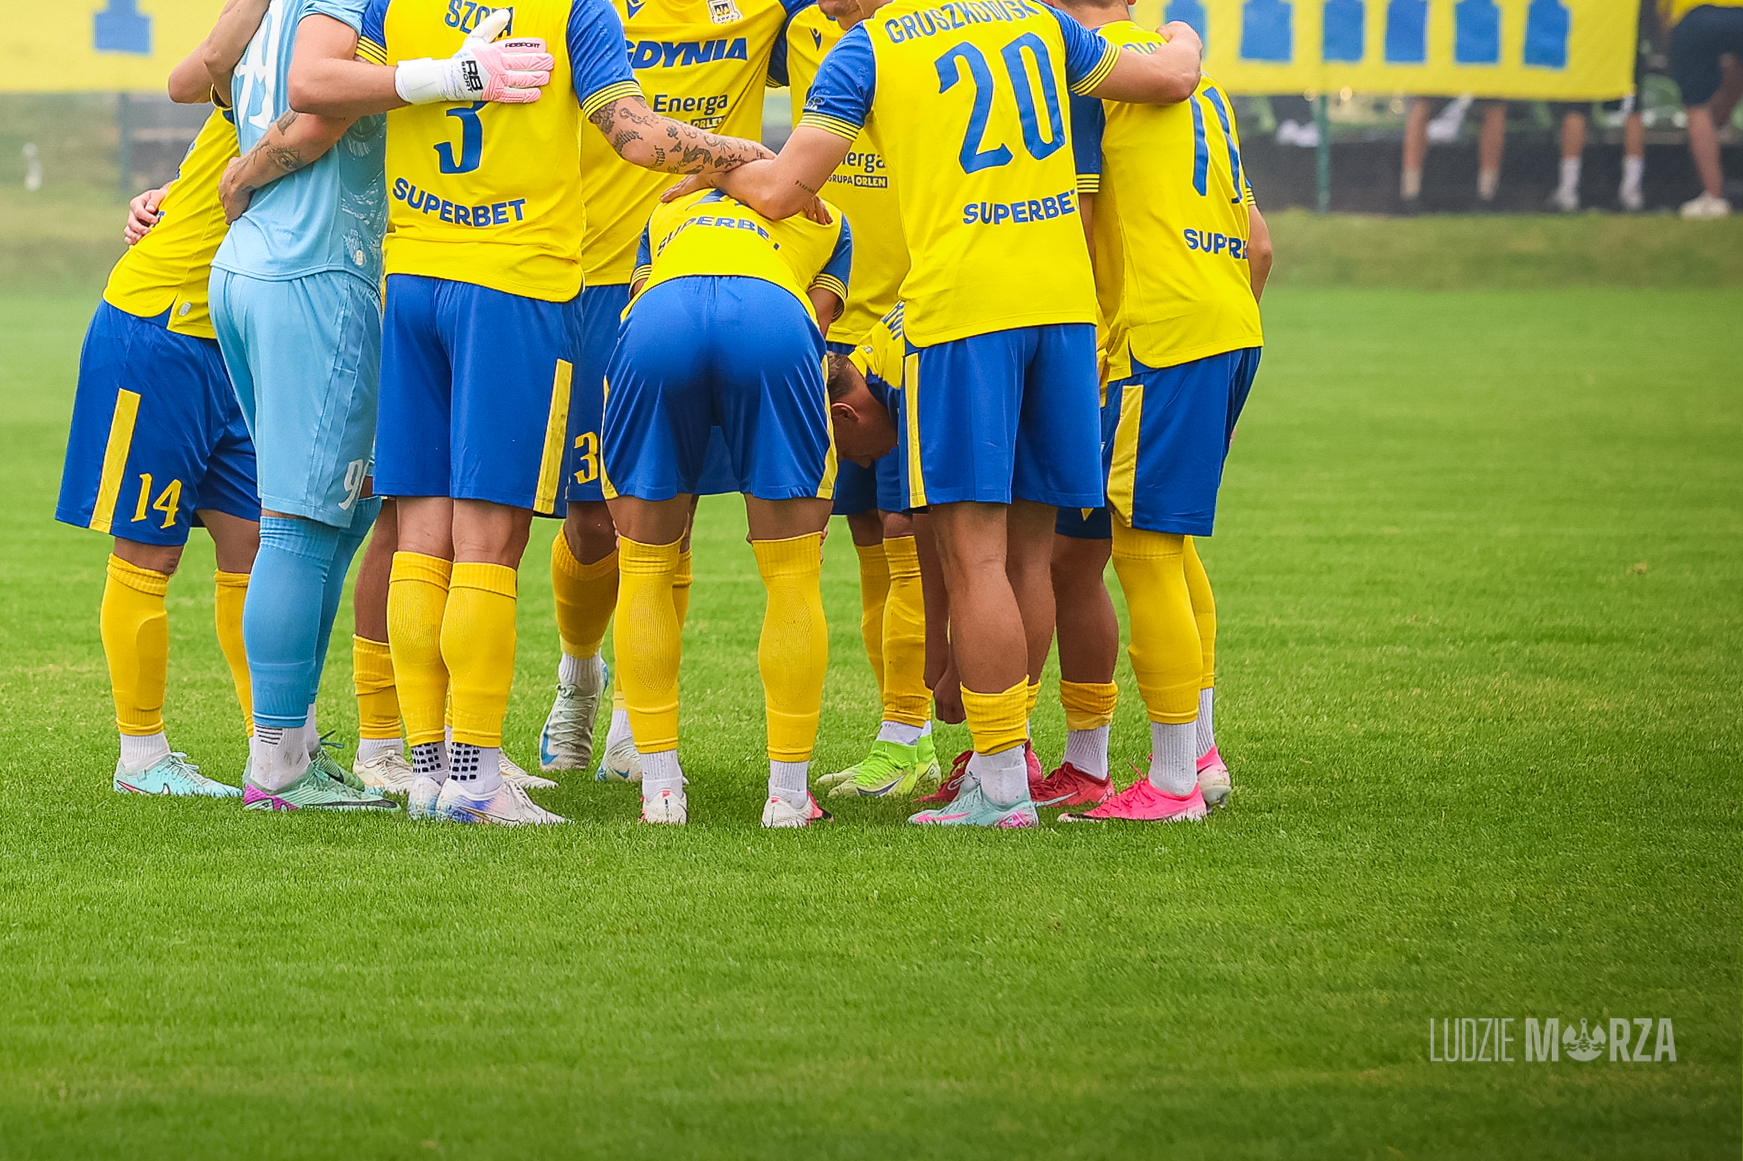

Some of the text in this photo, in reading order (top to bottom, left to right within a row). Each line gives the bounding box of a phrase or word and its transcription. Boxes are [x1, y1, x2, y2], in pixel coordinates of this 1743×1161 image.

[461, 61, 474, 93] SPORT
[465, 60, 484, 90] RB
[653, 93, 729, 116] Energa
[934, 32, 1066, 175] 20
[855, 176, 887, 187] ORLEN
[392, 177, 526, 228] SUPERBET
[130, 472, 183, 530] 14
